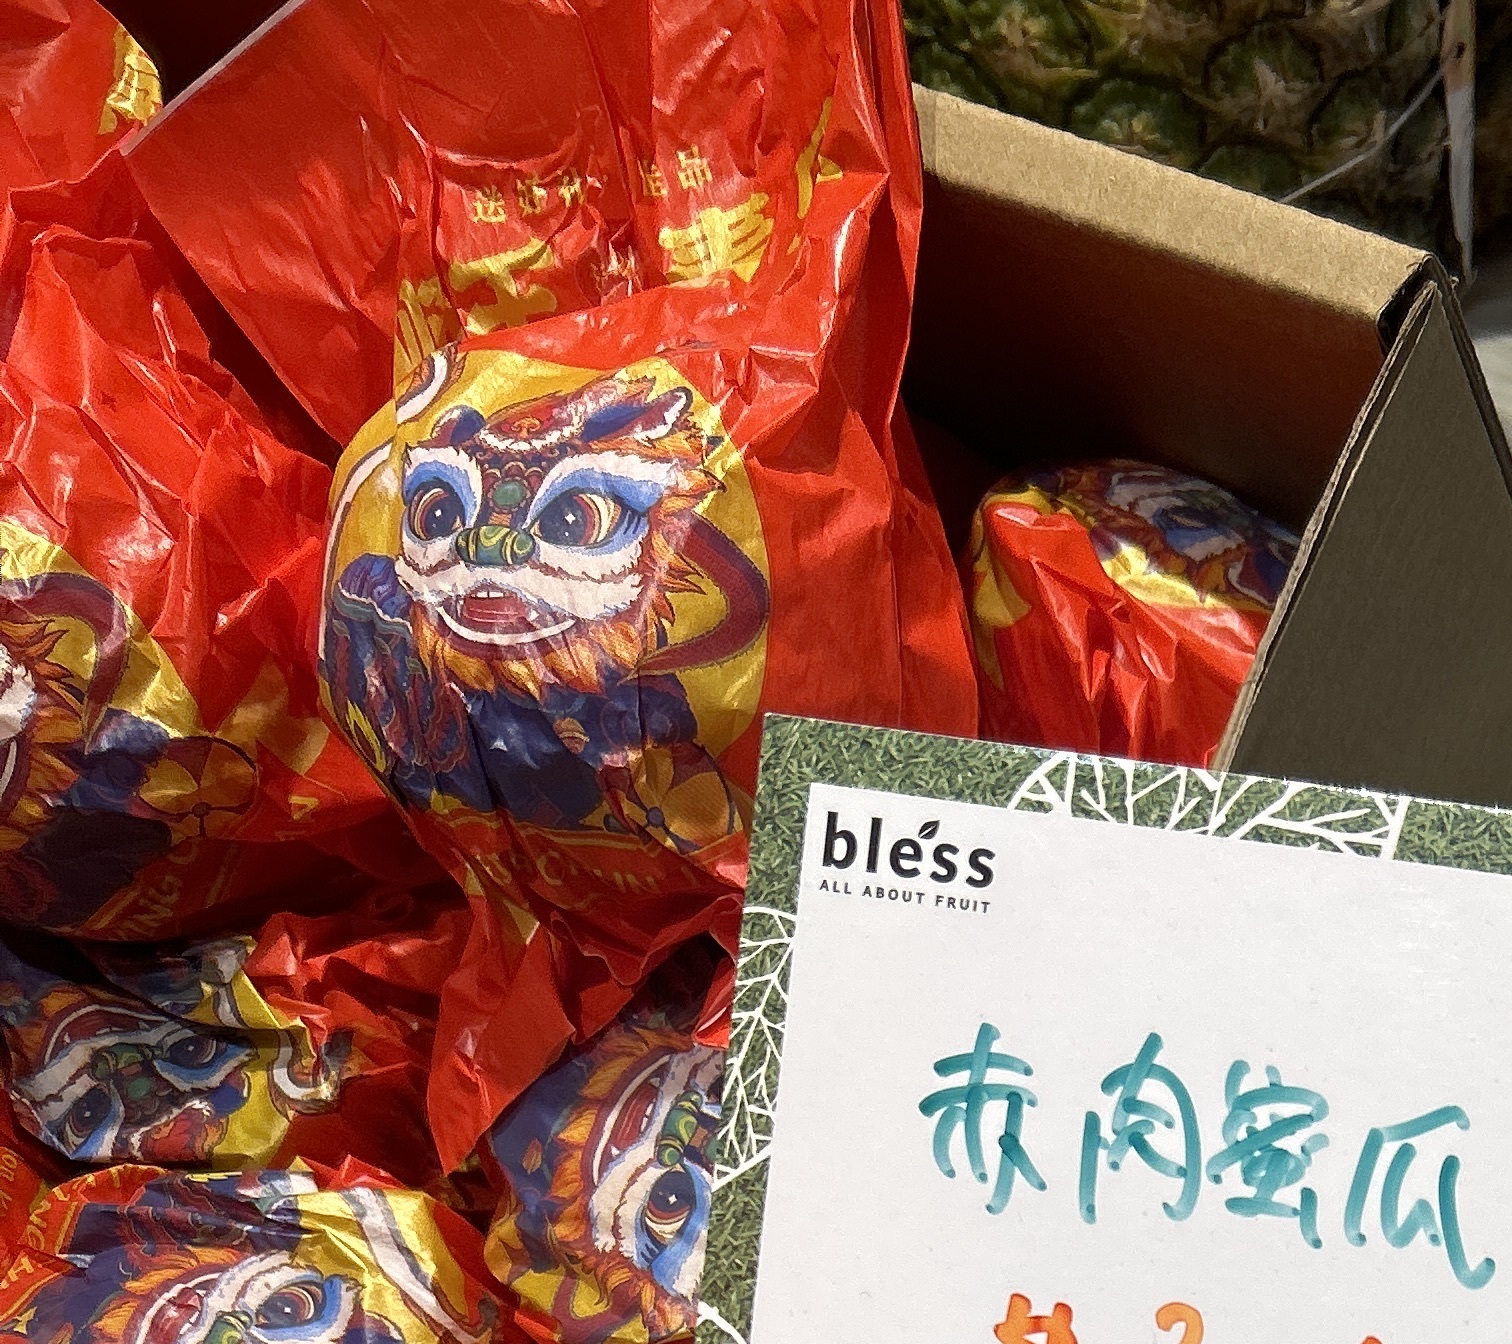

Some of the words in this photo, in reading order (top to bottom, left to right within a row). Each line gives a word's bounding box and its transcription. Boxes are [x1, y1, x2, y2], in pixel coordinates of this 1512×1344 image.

[819, 879, 852, 895] ALL
[862, 885, 925, 904] ABOUT
[935, 895, 991, 914] FRUIT
[919, 1022, 1496, 1289] 赤肉蜜瓜
